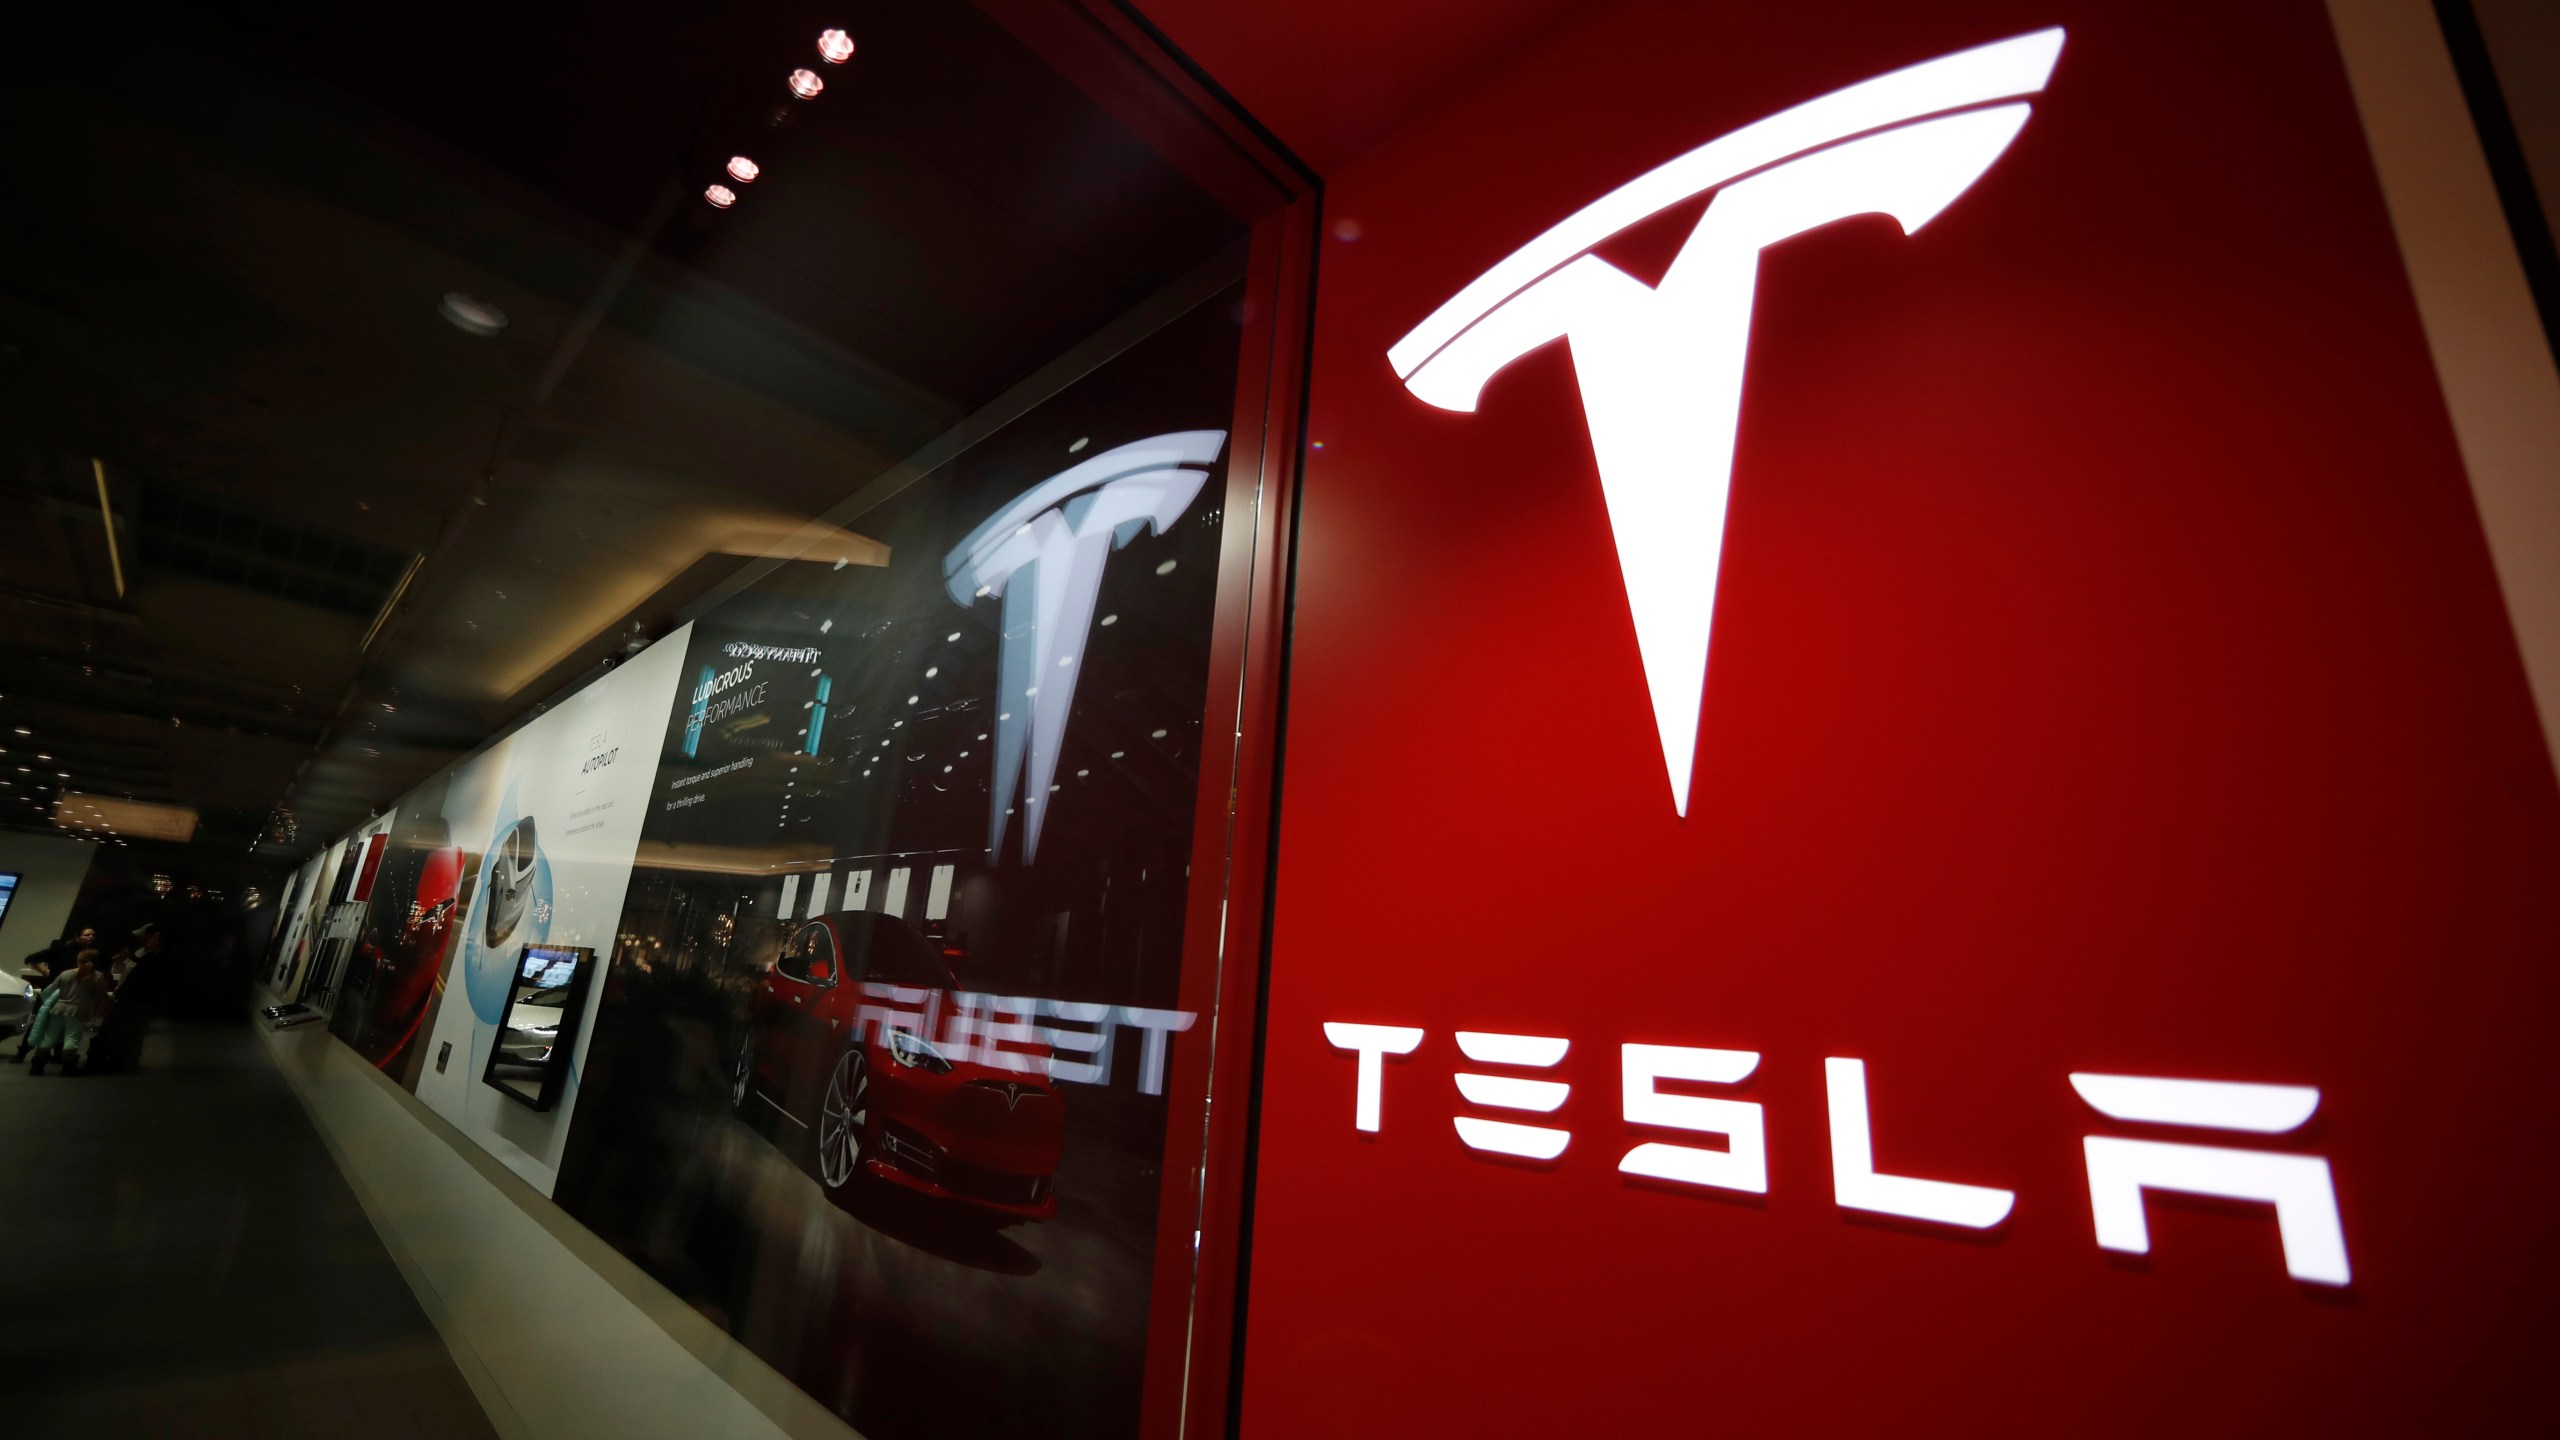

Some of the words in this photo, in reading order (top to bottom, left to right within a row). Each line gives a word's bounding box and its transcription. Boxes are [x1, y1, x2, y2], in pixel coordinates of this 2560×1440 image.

[692, 659, 754, 705] LUDICROUS
[685, 681, 769, 734] PERFORMANCE
[581, 747, 619, 776] AUTOPILOT
[701, 769, 711, 780] and
[710, 764, 731, 778] superior
[731, 757, 754, 771] handling
[1323, 1021, 2349, 1286] TESLA
